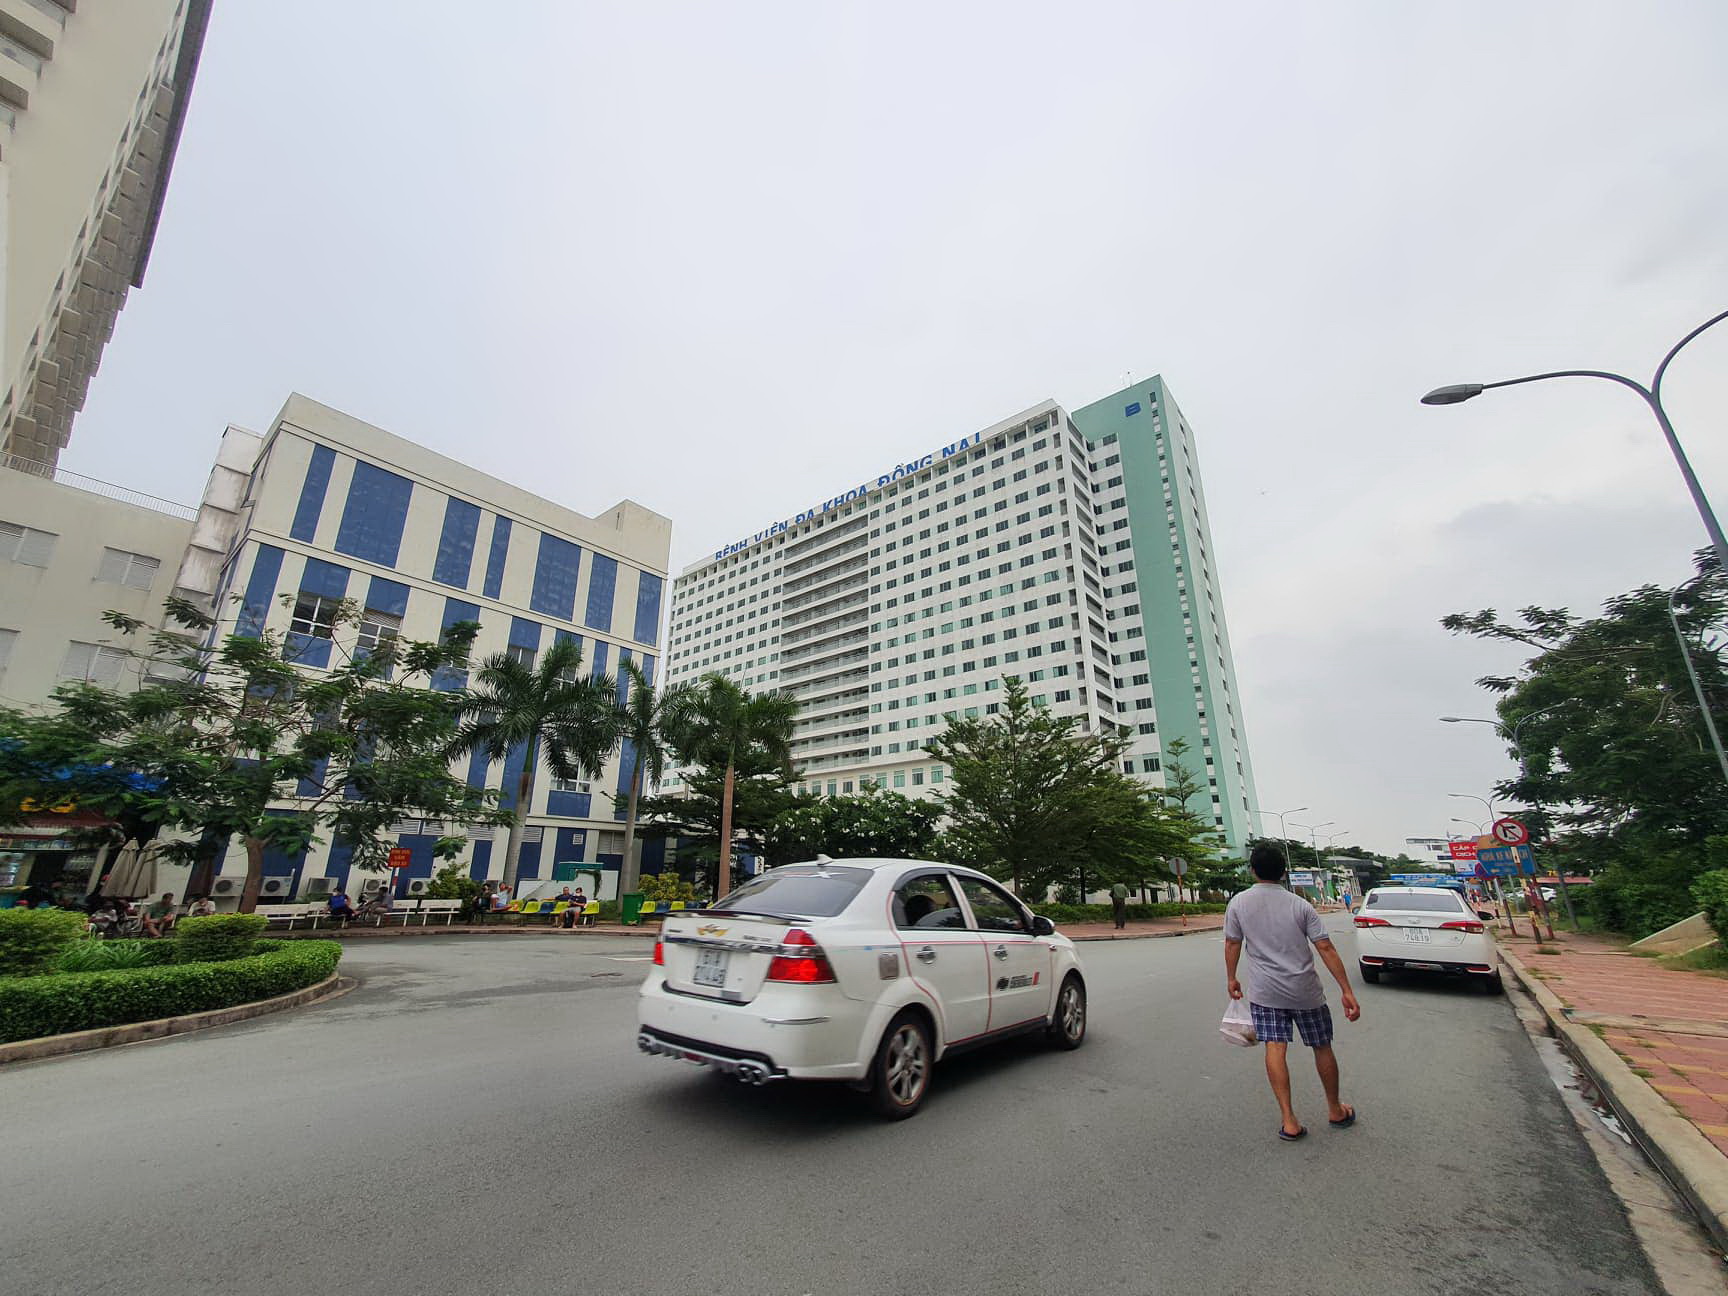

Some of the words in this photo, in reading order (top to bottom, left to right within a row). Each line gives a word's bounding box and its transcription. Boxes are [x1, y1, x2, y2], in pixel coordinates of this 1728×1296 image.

[795, 509, 814, 524] ĐA
[822, 485, 868, 512] KHOA
[942, 432, 980, 458] NAI
